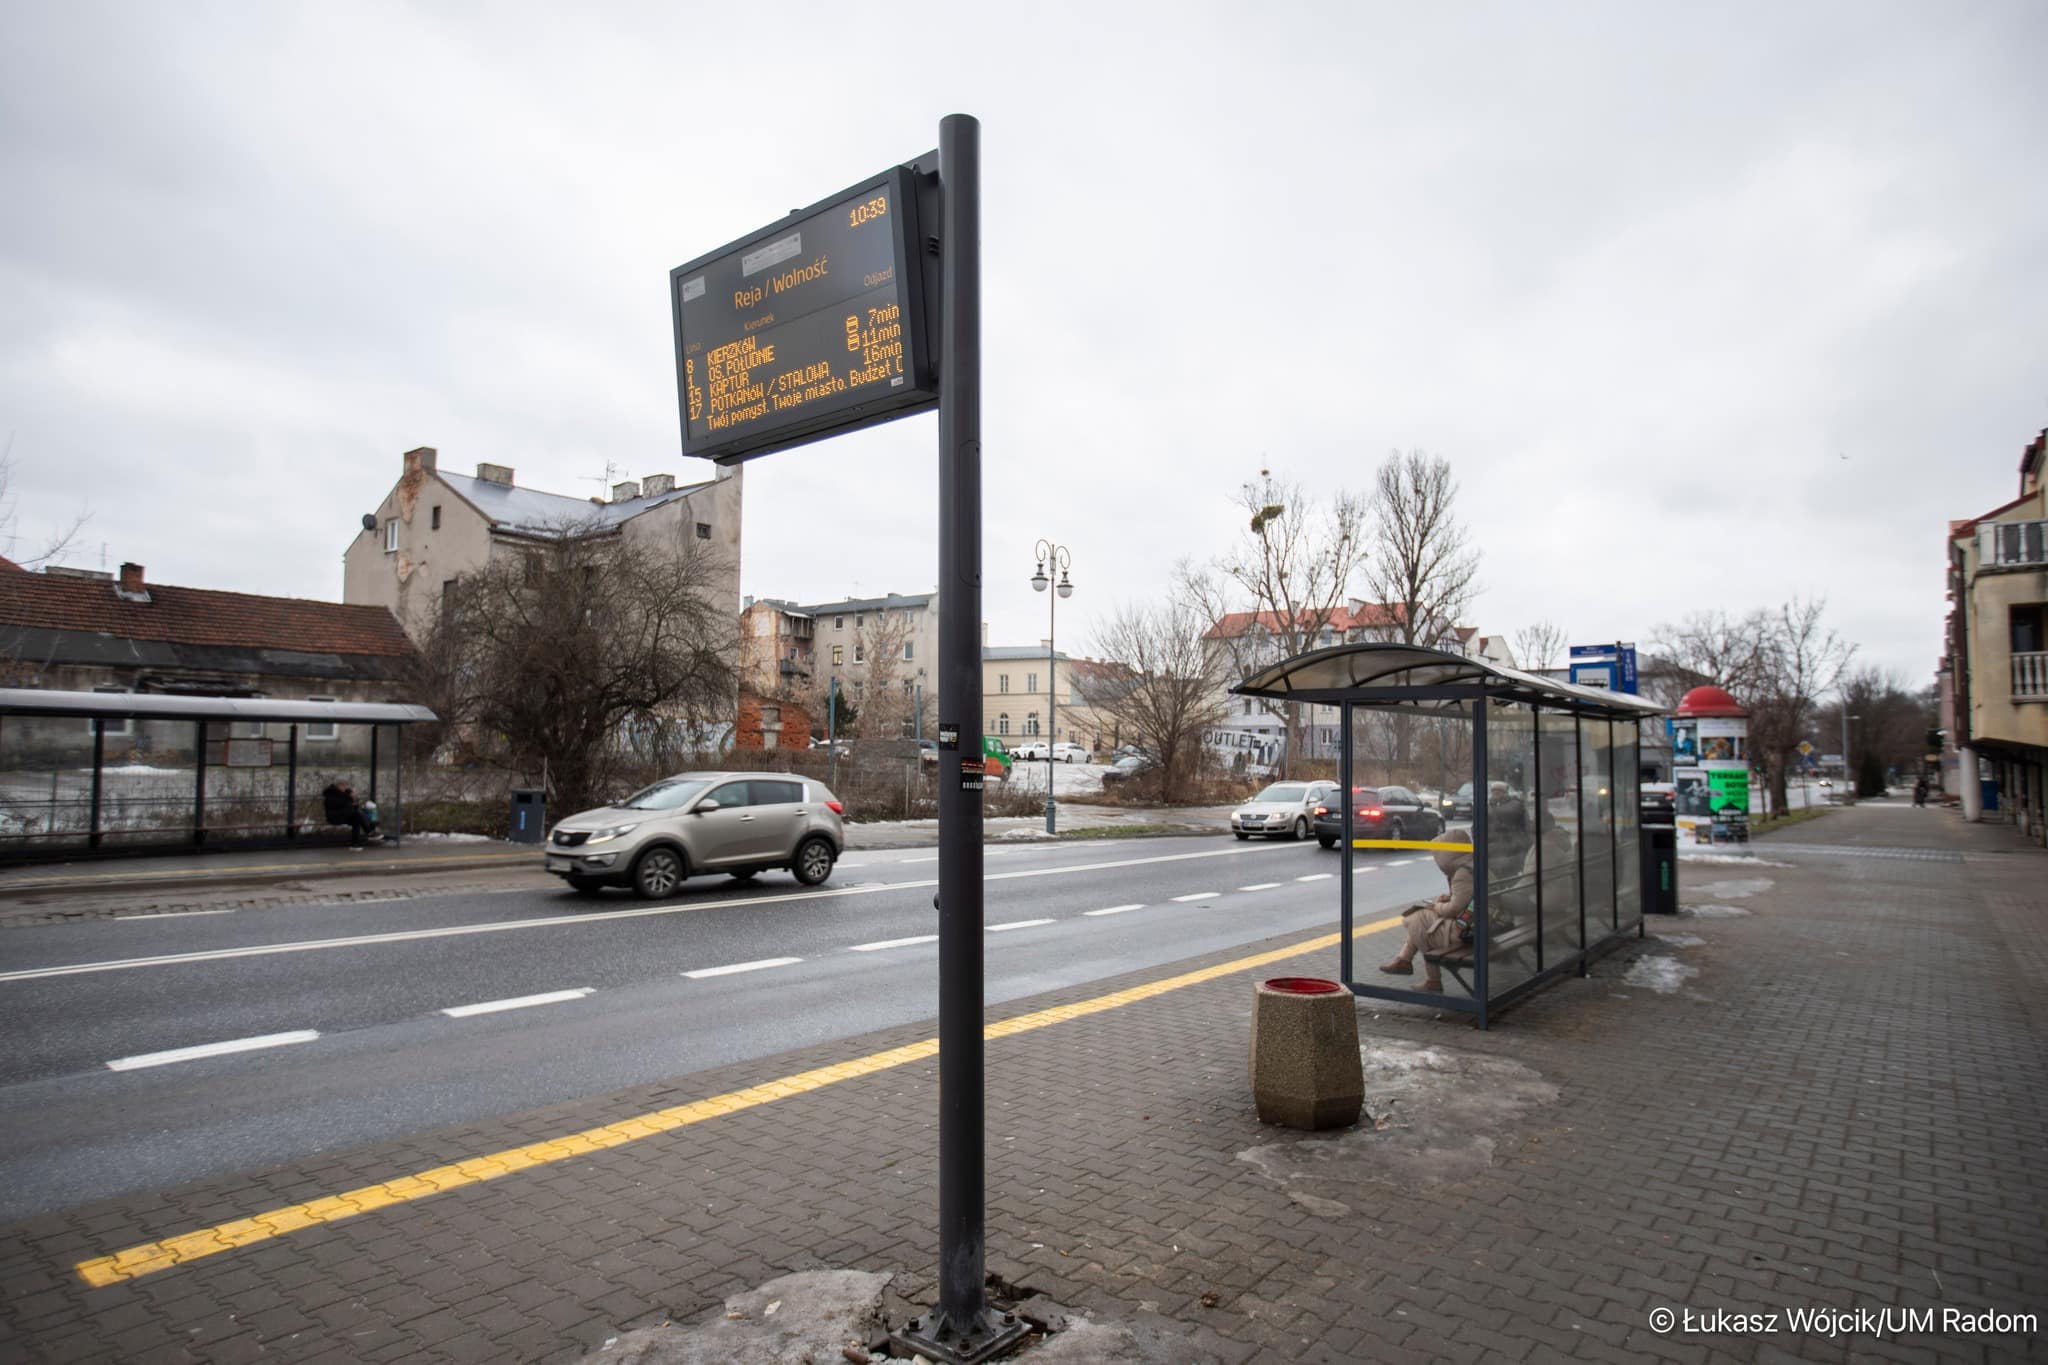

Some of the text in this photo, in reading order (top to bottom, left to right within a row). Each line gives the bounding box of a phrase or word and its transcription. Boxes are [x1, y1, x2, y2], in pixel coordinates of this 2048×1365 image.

[850, 196, 887, 227] 10:39
[735, 255, 829, 310] Reja / Wolność
[687, 375, 694, 390] 1
[868, 304, 900, 327] 7min
[687, 359, 694, 374] 8
[689, 322, 901, 405] 15 KAPTUR 11min
[690, 340, 902, 420] 17 POTKANÓW / STALOWA 16min
[707, 410, 729, 431] Twój
[771, 389, 802, 411] Twoje
[805, 376, 848, 401] miasto.
[849, 360, 891, 388] Budżet
[1203, 729, 1256, 749] OUTLET
